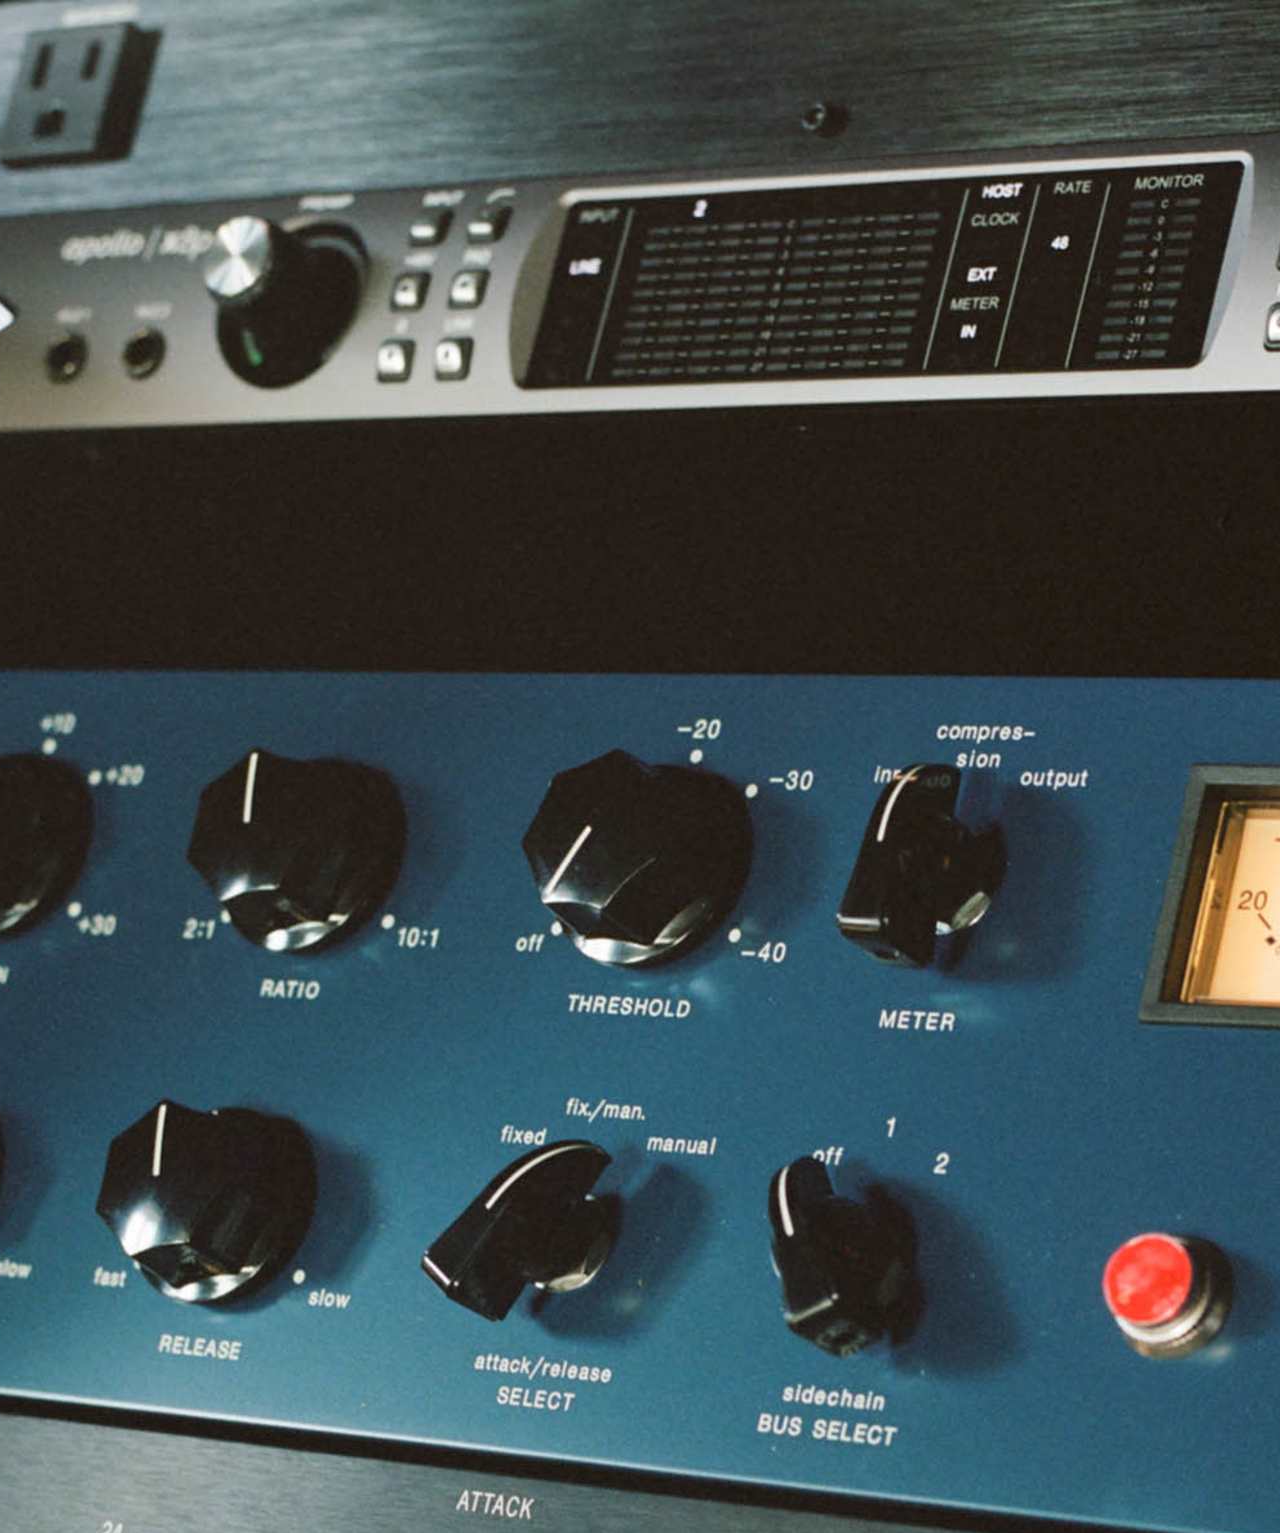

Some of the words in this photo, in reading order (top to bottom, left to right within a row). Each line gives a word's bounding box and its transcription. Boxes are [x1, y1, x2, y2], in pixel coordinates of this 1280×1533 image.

[982, 183, 1023, 198] HOST
[1054, 181, 1092, 195] RATE
[1134, 174, 1204, 190] MONITOR
[970, 212, 1020, 227] CLOCK
[1050, 236, 1069, 250] 48
[967, 267, 997, 282] EXT
[1137, 281, 1154, 292] -12
[950, 297, 1000, 311] METER
[960, 324, 977, 338] IN
[676, 718, 722, 740] -20
[936, 722, 1036, 744] compres-
[955, 748, 1002, 769] sion
[105, 765, 145, 786] +20
[769, 770, 814, 792] -30
[1020, 768, 1090, 791] output
[1237, 890, 1269, 912] 20
[77, 913, 117, 936] +30
[182, 917, 216, 940] 2:1
[397, 926, 440, 949] 10:1
[515, 932, 546, 954] off
[740, 942, 786, 964] -40
[259, 977, 321, 1001] RATIO
[566, 993, 692, 1020] THRESHOLD
[878, 1008, 956, 1033] METER
[564, 1097, 647, 1123] fix./man.
[499, 1125, 549, 1146] fixed
[885, 1118, 898, 1138] 1
[646, 1135, 718, 1156] manual
[812, 1146, 844, 1167] off
[933, 1152, 951, 1176] 2
[93, 1266, 127, 1289] fast
[307, 1288, 351, 1310] slow
[158, 1334, 242, 1361] RELEASE
[473, 1352, 613, 1385] attack/release
[496, 1385, 576, 1412] SELECT
[782, 1383, 886, 1412] sidechain
[757, 1413, 803, 1437] BUS
[811, 1418, 899, 1447] SELECT
[456, 1489, 535, 1520] ATTACK
